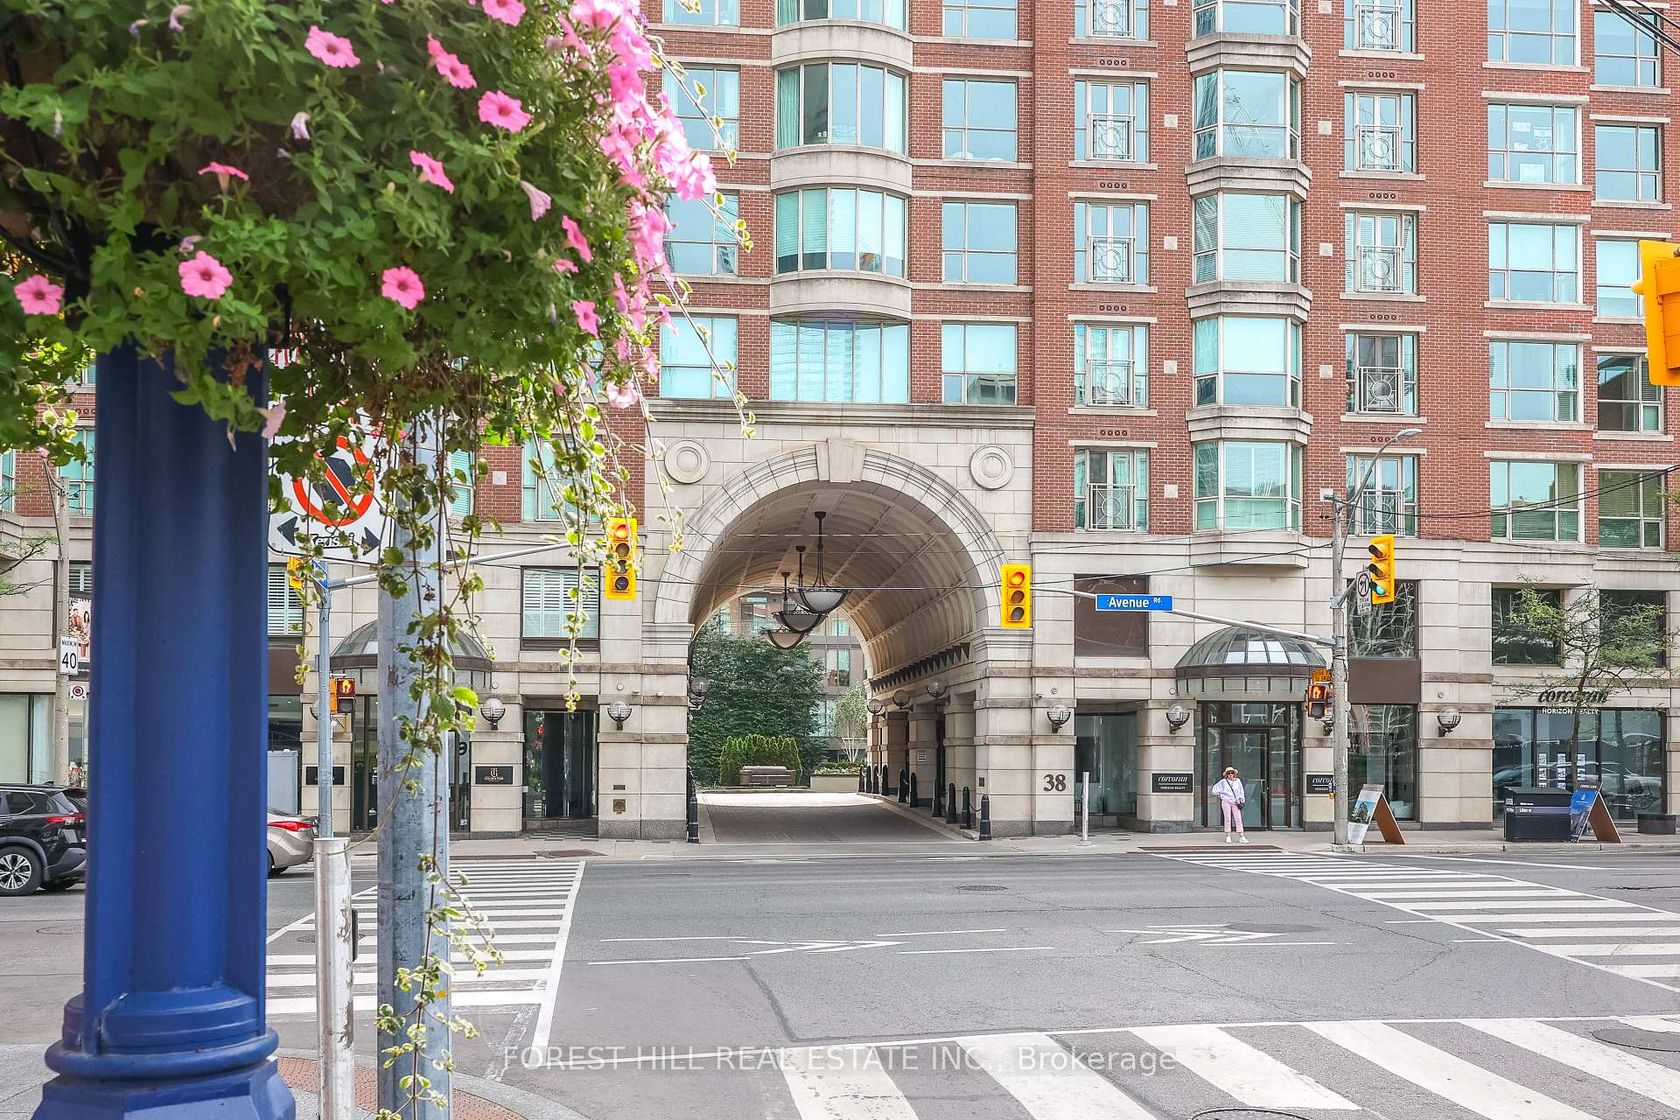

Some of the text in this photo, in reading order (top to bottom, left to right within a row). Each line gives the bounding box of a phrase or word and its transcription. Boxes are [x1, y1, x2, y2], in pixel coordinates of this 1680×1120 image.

[1108, 596, 1150, 608] Avenue
[61, 652, 77, 669] 40
[1043, 773, 1067, 792] 38
